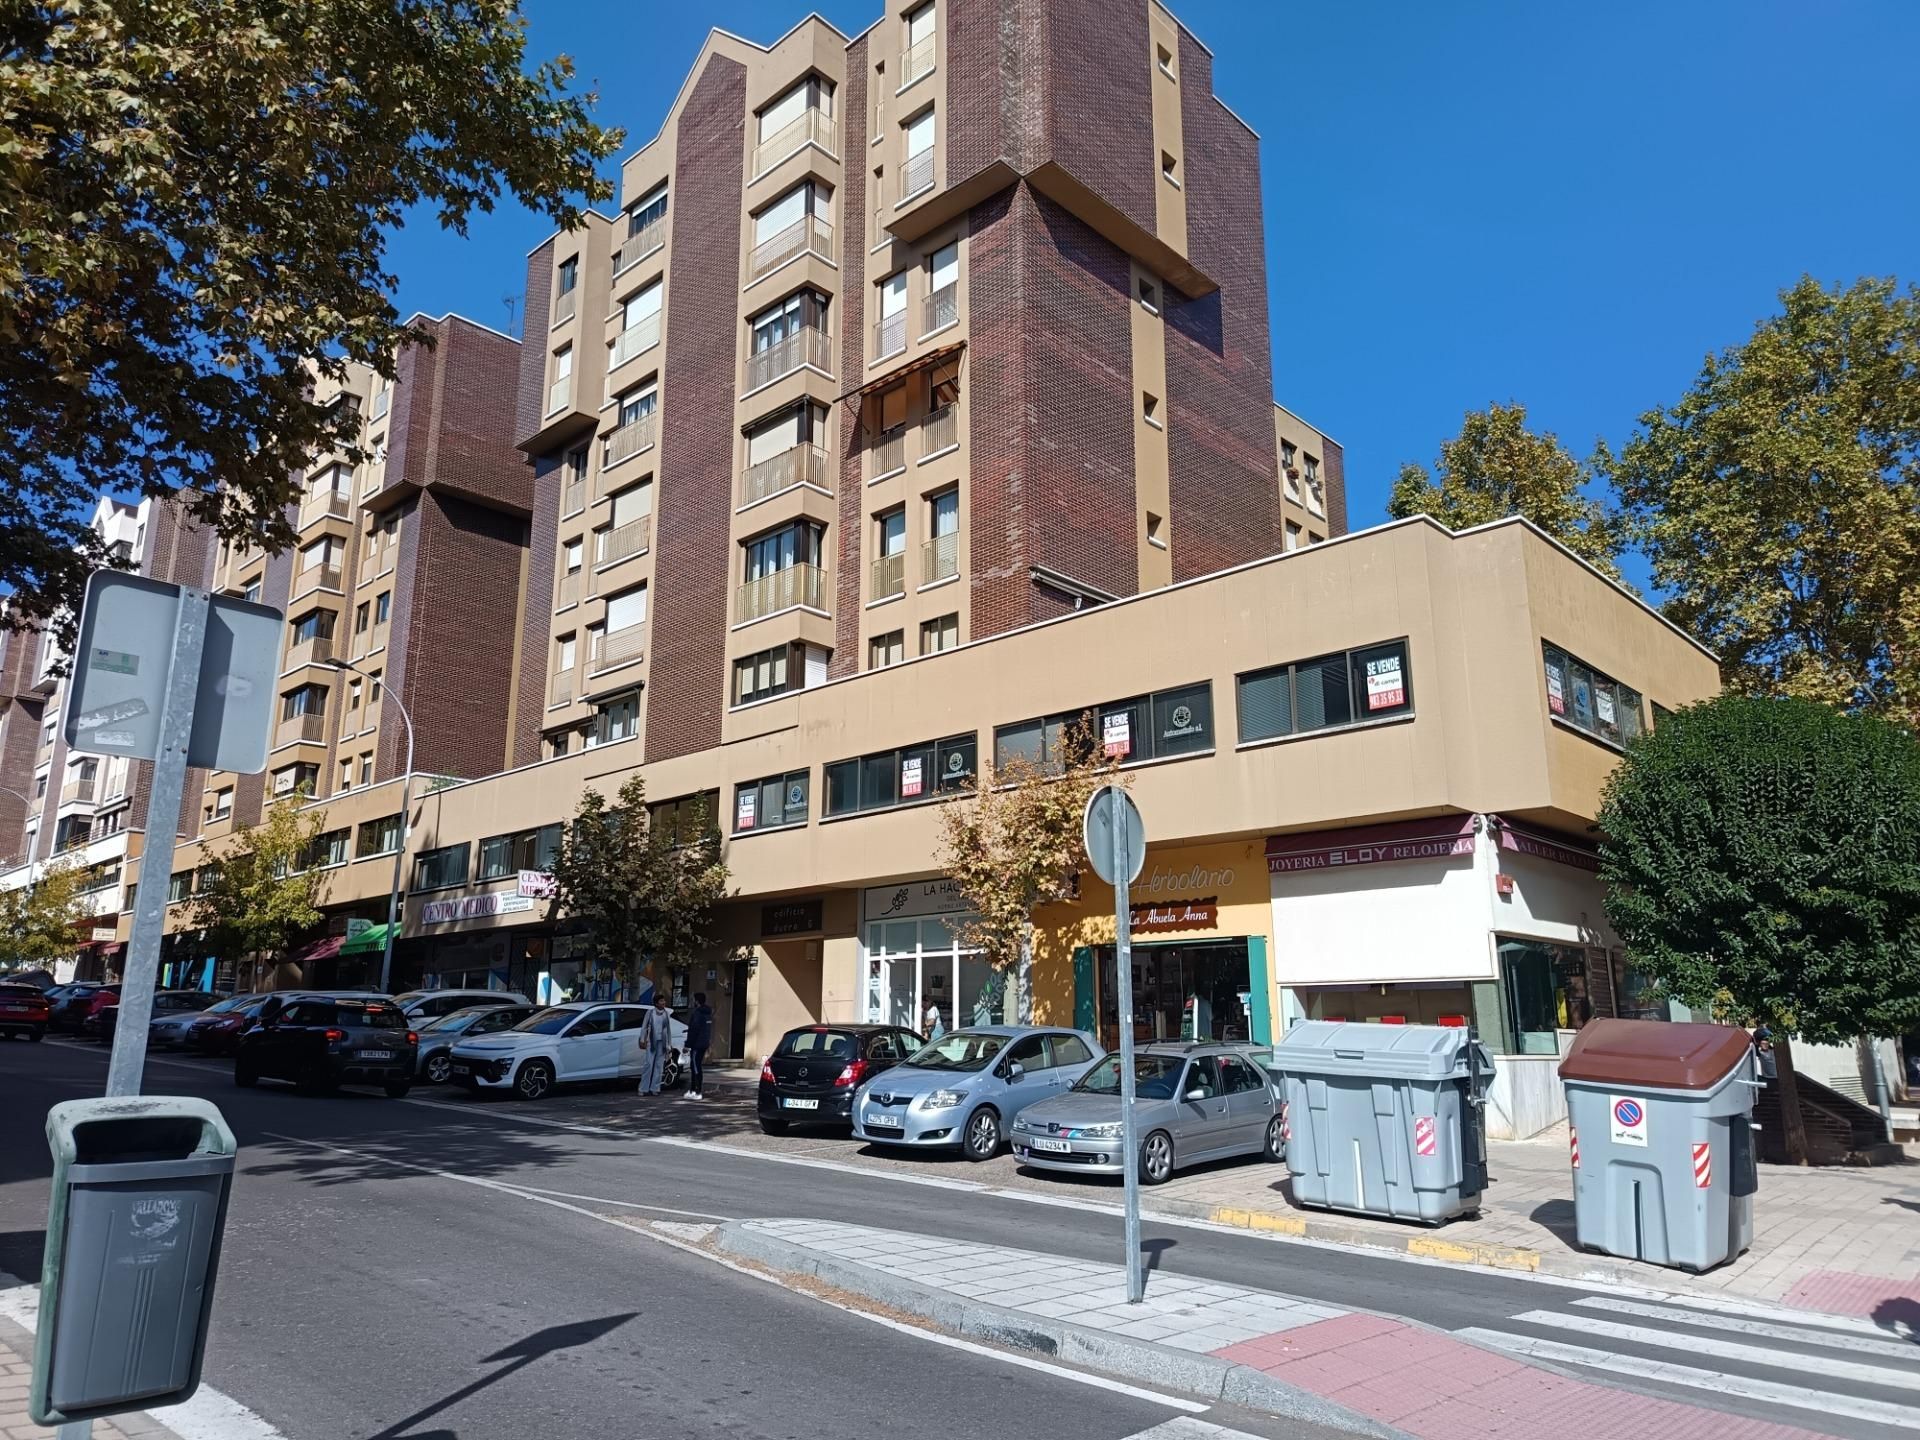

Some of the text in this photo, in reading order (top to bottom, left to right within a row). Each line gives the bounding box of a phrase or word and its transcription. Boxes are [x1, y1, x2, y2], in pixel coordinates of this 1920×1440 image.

[1366, 656, 1400, 676] SE VENDE
[1104, 712, 1129, 729] SE VENDE
[909, 757, 922, 770] VENDE
[1270, 839, 1474, 872] JOYERIA ELOY RELOJERIA
[924, 883, 936, 896] LA
[1129, 864, 1236, 895] Herbolario
[522, 885, 556, 897] MEICO
[423, 894, 498, 922] CENTRO MEDICO
[1129, 905, 1208, 926] La Abuela Anna
